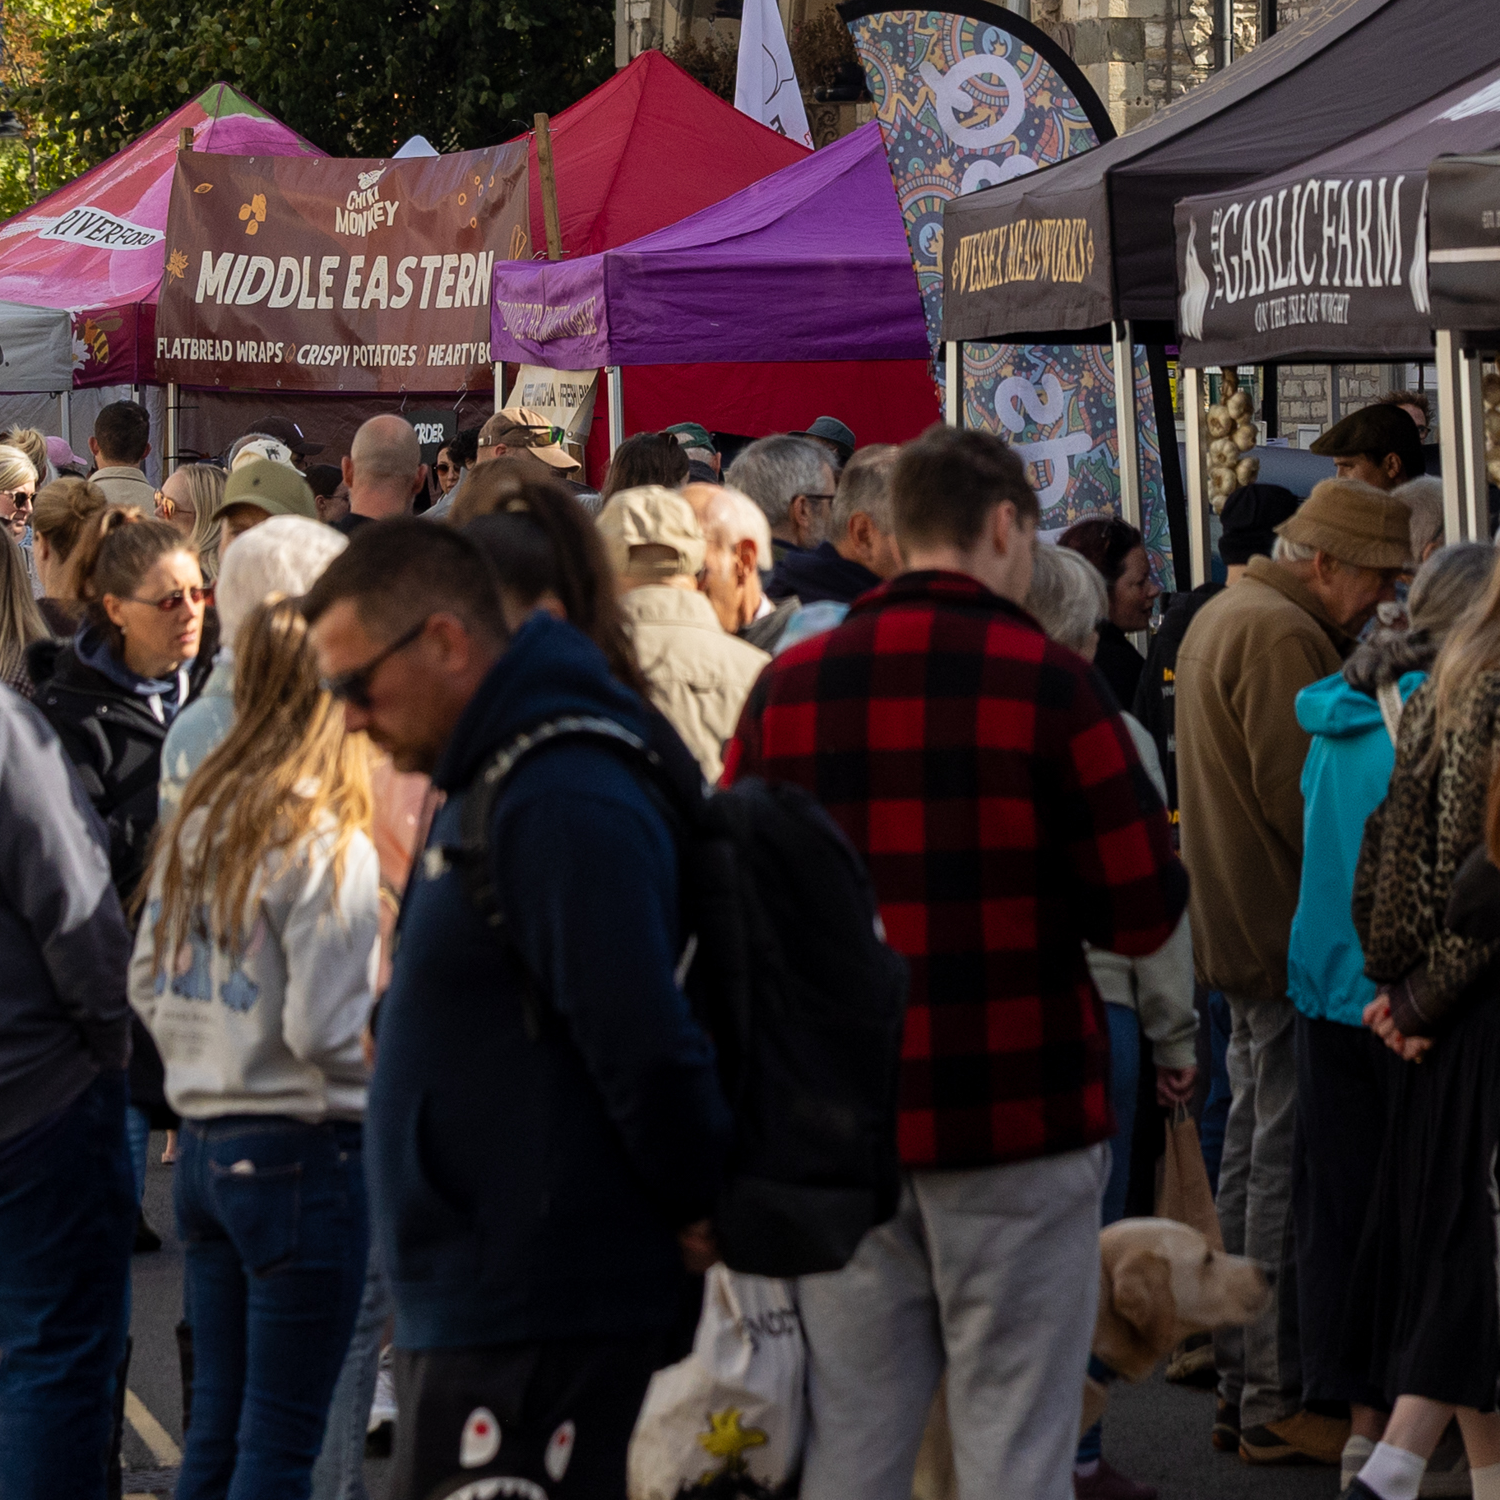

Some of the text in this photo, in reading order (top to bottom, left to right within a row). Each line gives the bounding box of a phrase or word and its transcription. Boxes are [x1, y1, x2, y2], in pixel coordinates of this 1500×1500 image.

[346, 185, 380, 211] CHIKI
[44, 209, 156, 246] RIVERFORD
[335, 200, 399, 237] MONKEY
[959, 217, 1088, 296] WESSEX MEADWORKS
[1219, 175, 1406, 304] GARLIC FARM
[195, 250, 494, 309] MIDDLE EASTERN
[1254, 291, 1351, 333] ON THE ISLE OF WIGHT
[157, 337, 233, 362] FLATBREAD
[236, 340, 284, 364] WRAPS
[297, 343, 351, 367] CRISPY
[352, 344, 418, 367] POTATOES
[426, 342, 478, 367] HEARTY
